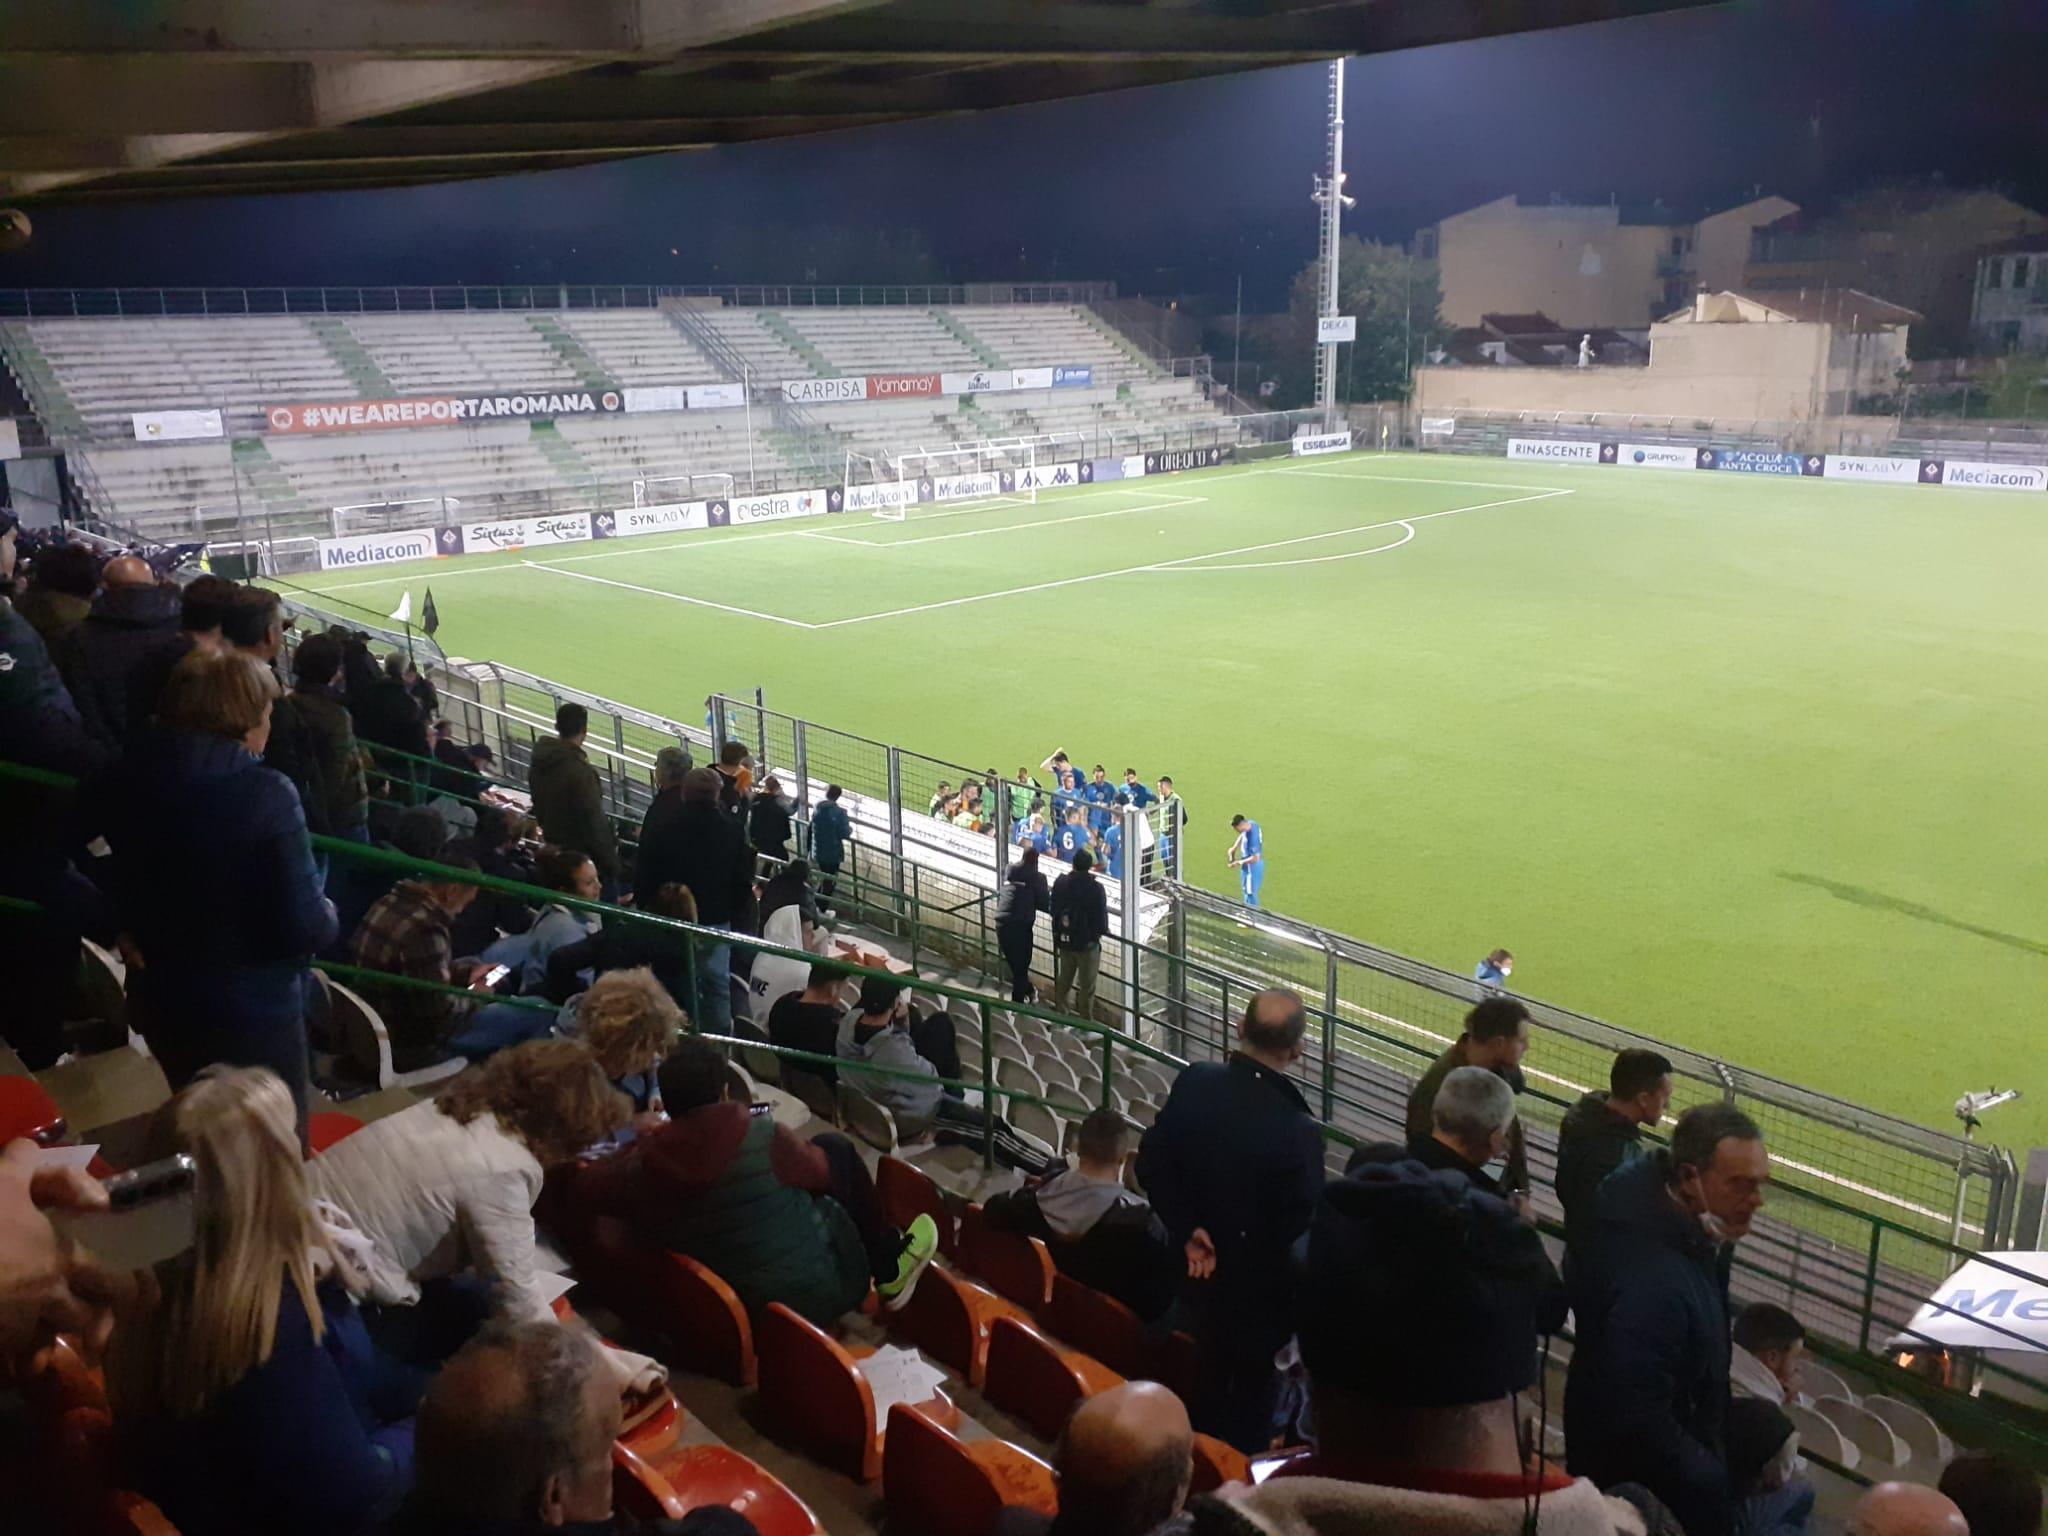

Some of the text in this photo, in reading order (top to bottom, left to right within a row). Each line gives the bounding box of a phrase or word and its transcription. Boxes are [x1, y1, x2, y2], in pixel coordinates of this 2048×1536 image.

[789, 381, 861, 400] CARPISA
[303, 393, 596, 427] #WEAREPORTAROMANA
[1302, 437, 1348, 451] ESSELUNGA
[1515, 444, 1593, 458] RINASCENTE
[1719, 461, 1793, 473] SANTA CROCE
[1949, 468, 2034, 487] Mediacom
[751, 498, 790, 518] estra
[327, 542, 423, 566] Mediacom
[1062, 831, 1075, 850] 6
